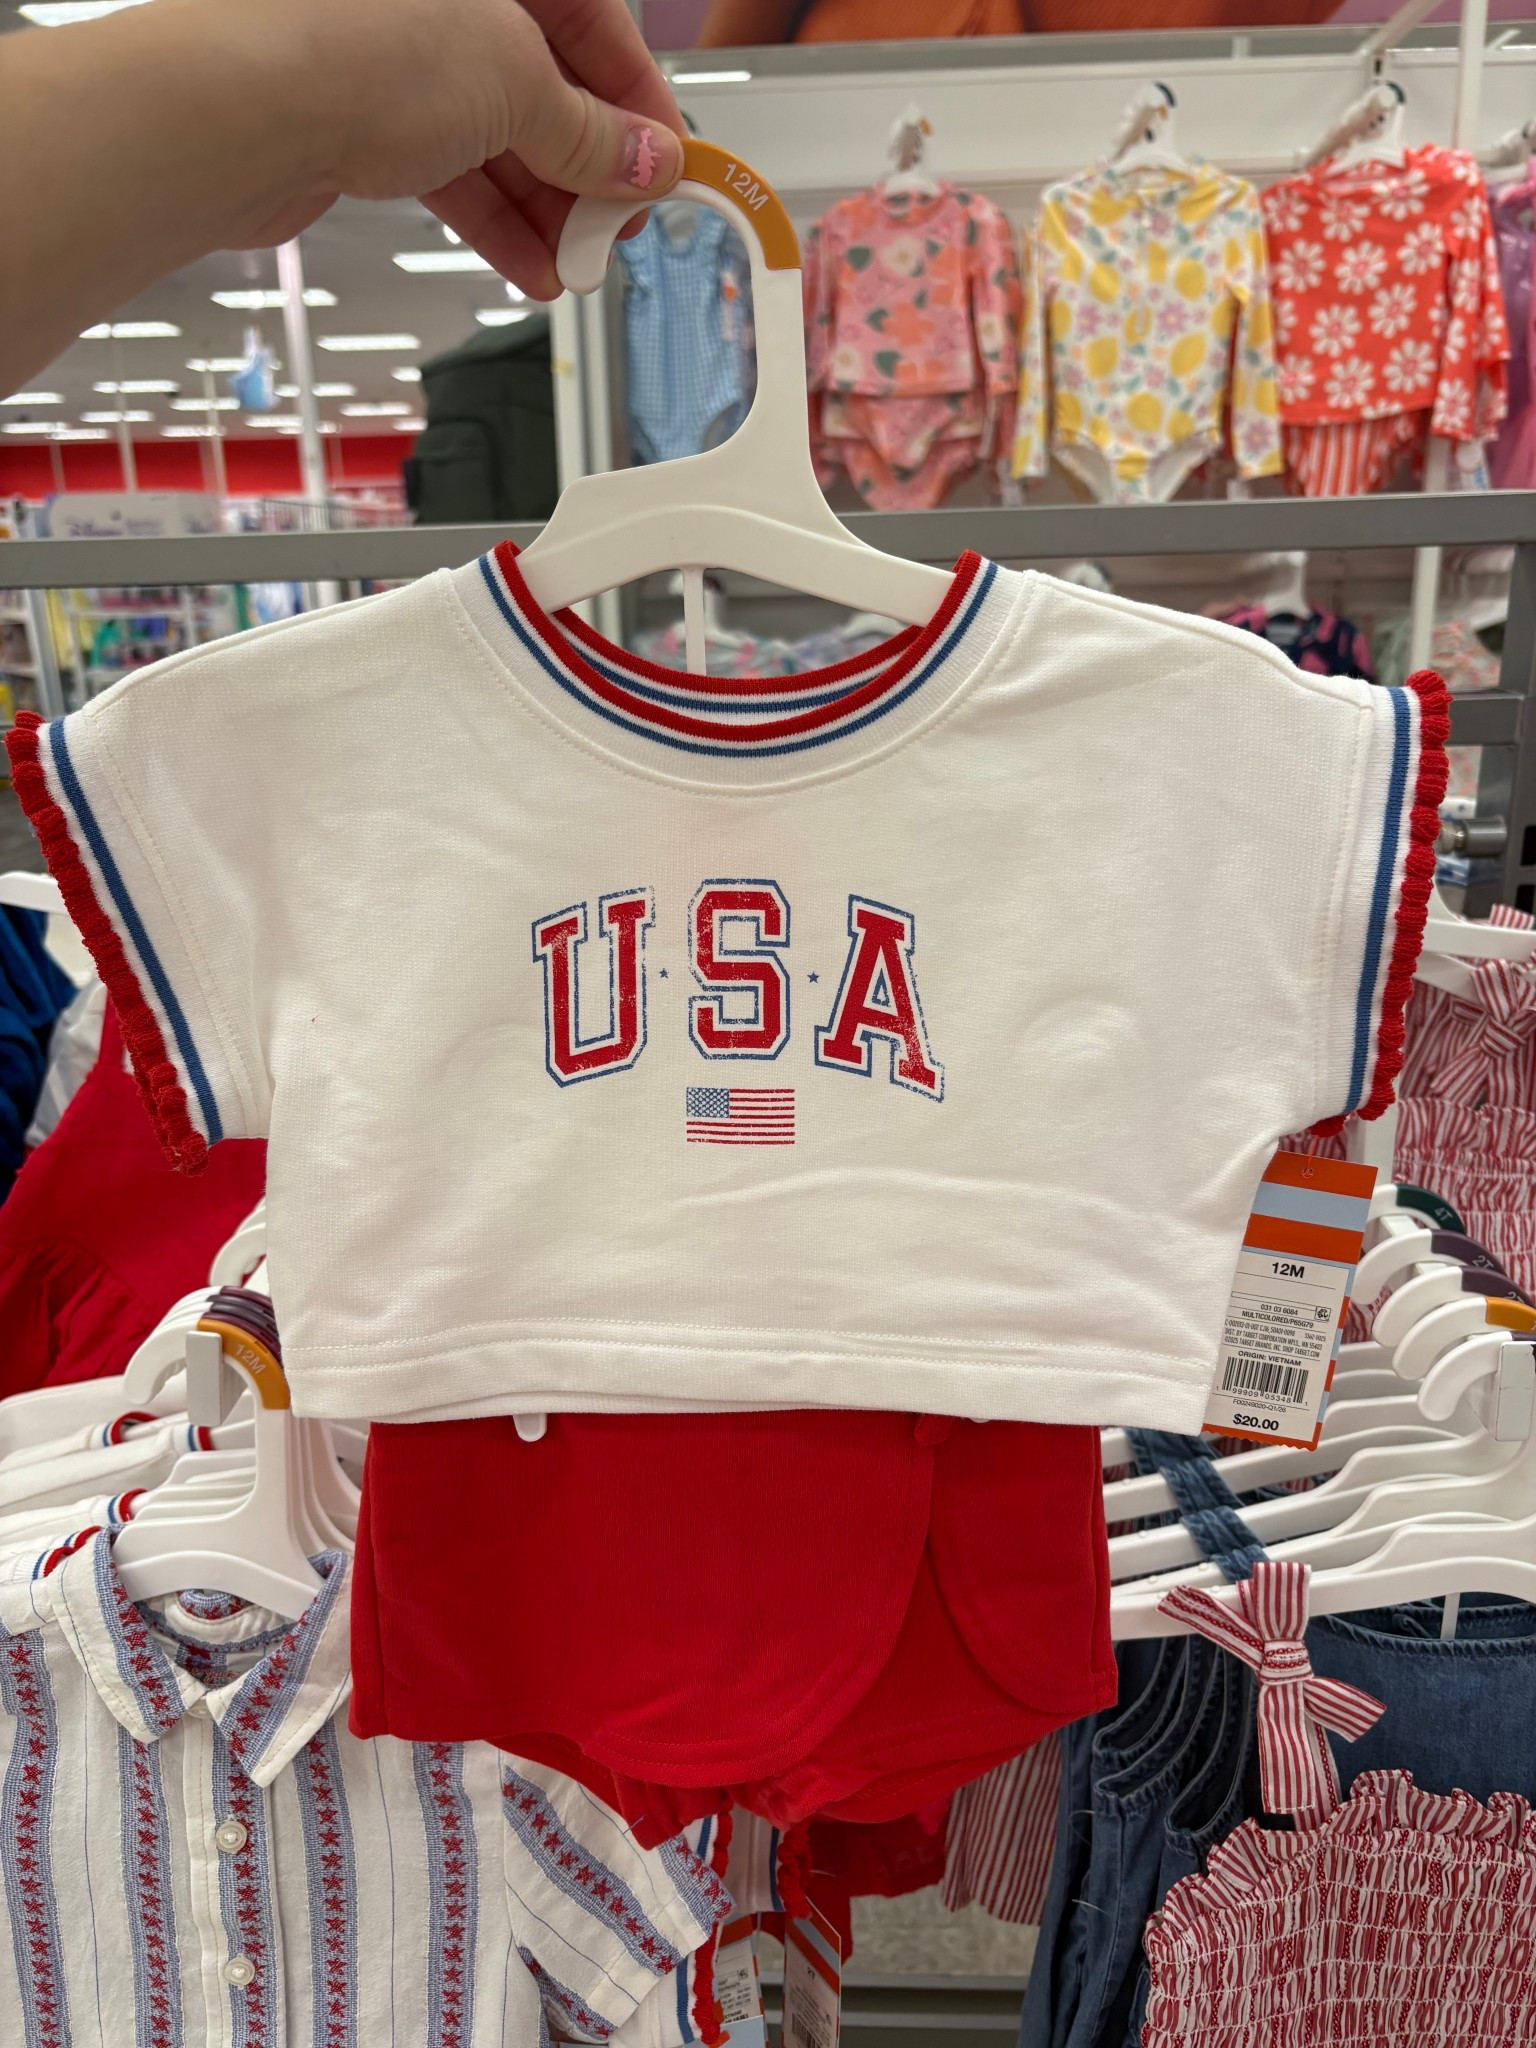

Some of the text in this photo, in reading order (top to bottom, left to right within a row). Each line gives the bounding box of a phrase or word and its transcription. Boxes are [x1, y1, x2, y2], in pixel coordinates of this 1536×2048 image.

[724, 163, 769, 211] 12M
[1434, 1207, 1453, 1222] 4T
[1272, 1262, 1305, 1278] 12M
[1260, 1303, 1298, 1316] 031 03 6084
[1239, 1338, 1254, 1347] TARGET
[1243, 1331, 1258, 1339] TARGET
[1258, 1333, 1287, 1344] CORPORATION
[235, 1344, 267, 1374] 12M
[1238, 1350, 1301, 1366] ORIGIN: VIETNAM
[1232, 1388, 1259, 1397] 99909
[1265, 1393, 1291, 1403] 05348
[1232, 1413, 1279, 1431] $20.00
